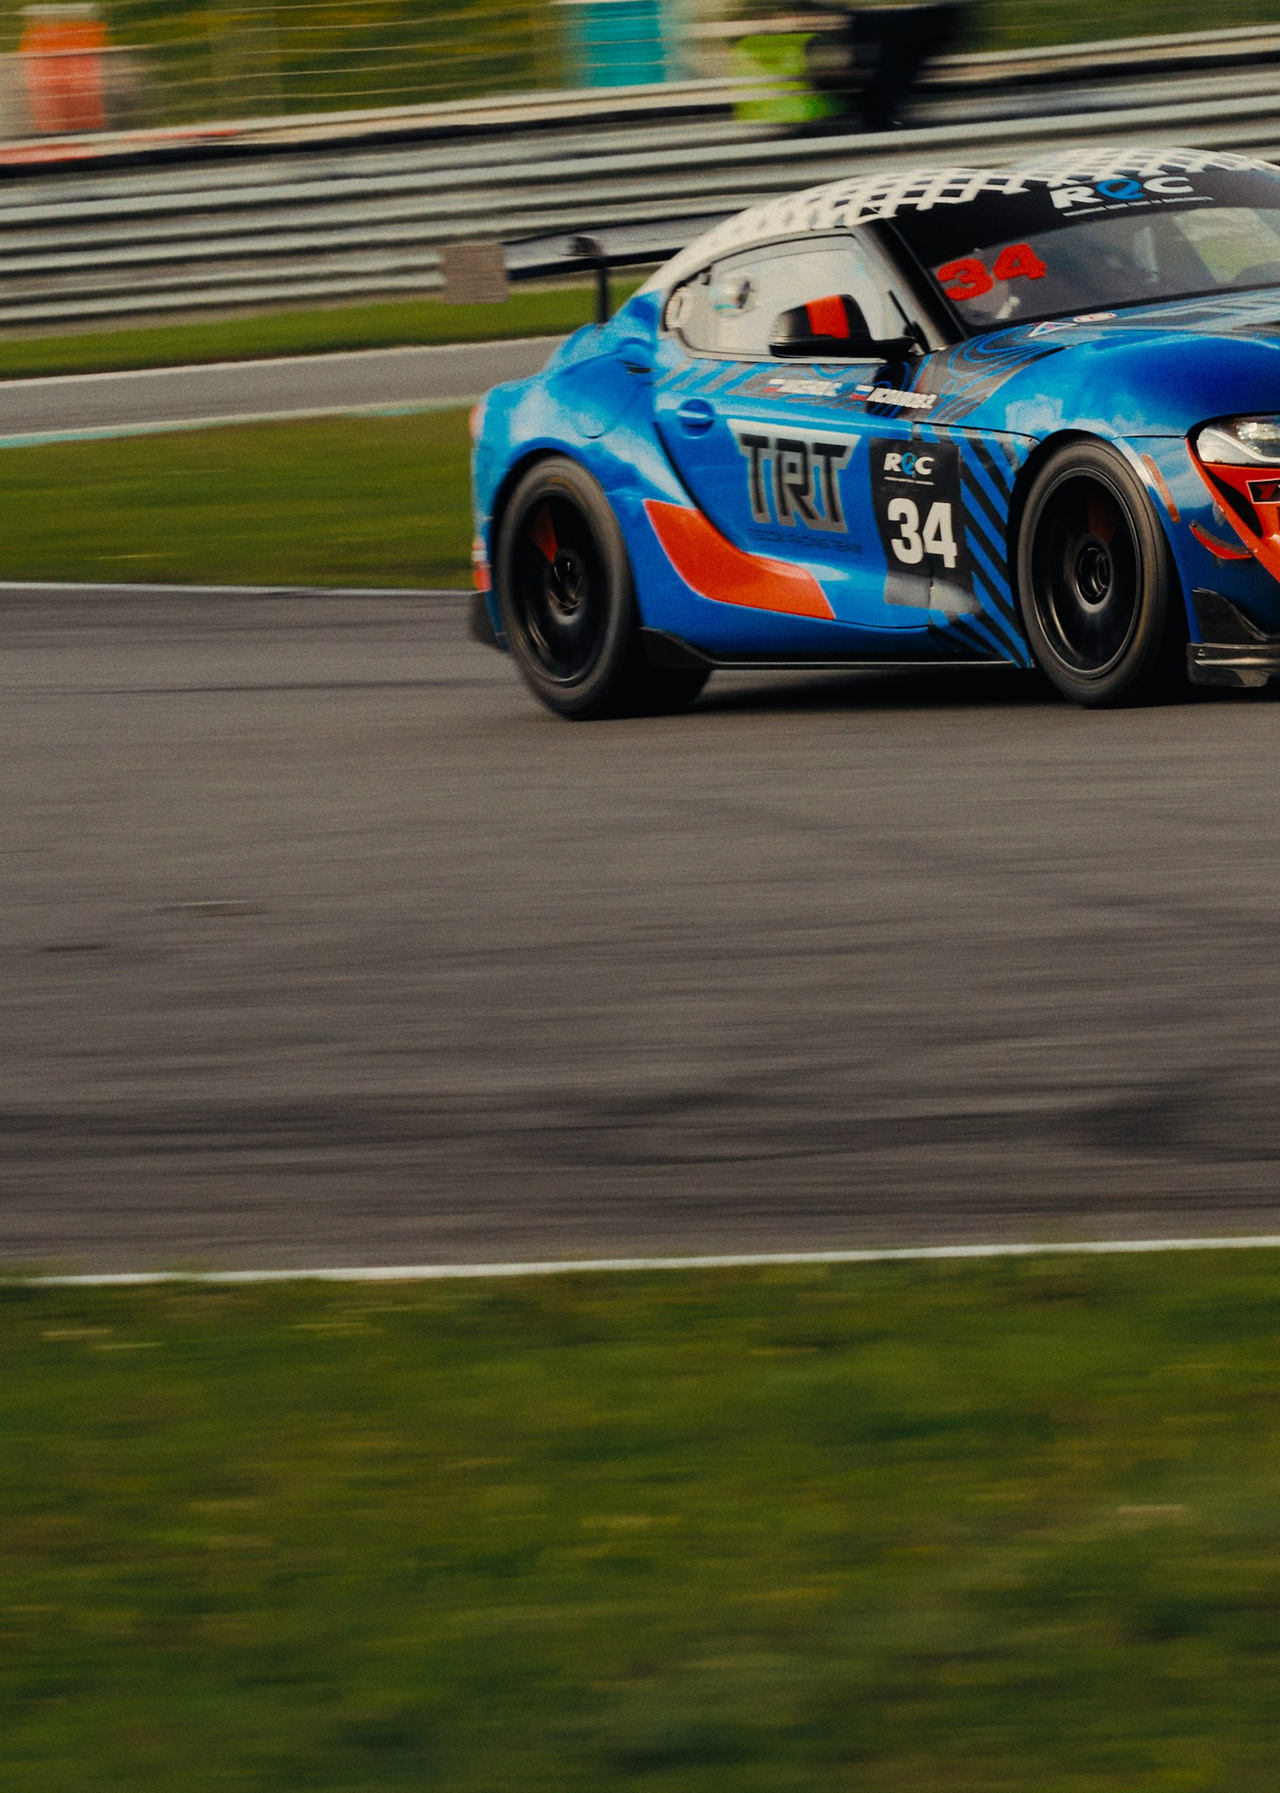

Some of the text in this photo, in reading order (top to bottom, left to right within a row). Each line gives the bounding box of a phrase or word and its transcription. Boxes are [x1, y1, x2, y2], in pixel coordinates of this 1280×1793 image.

[937, 243, 1048, 301] 34
[736, 430, 850, 529] TRT
[887, 498, 958, 569] 34
